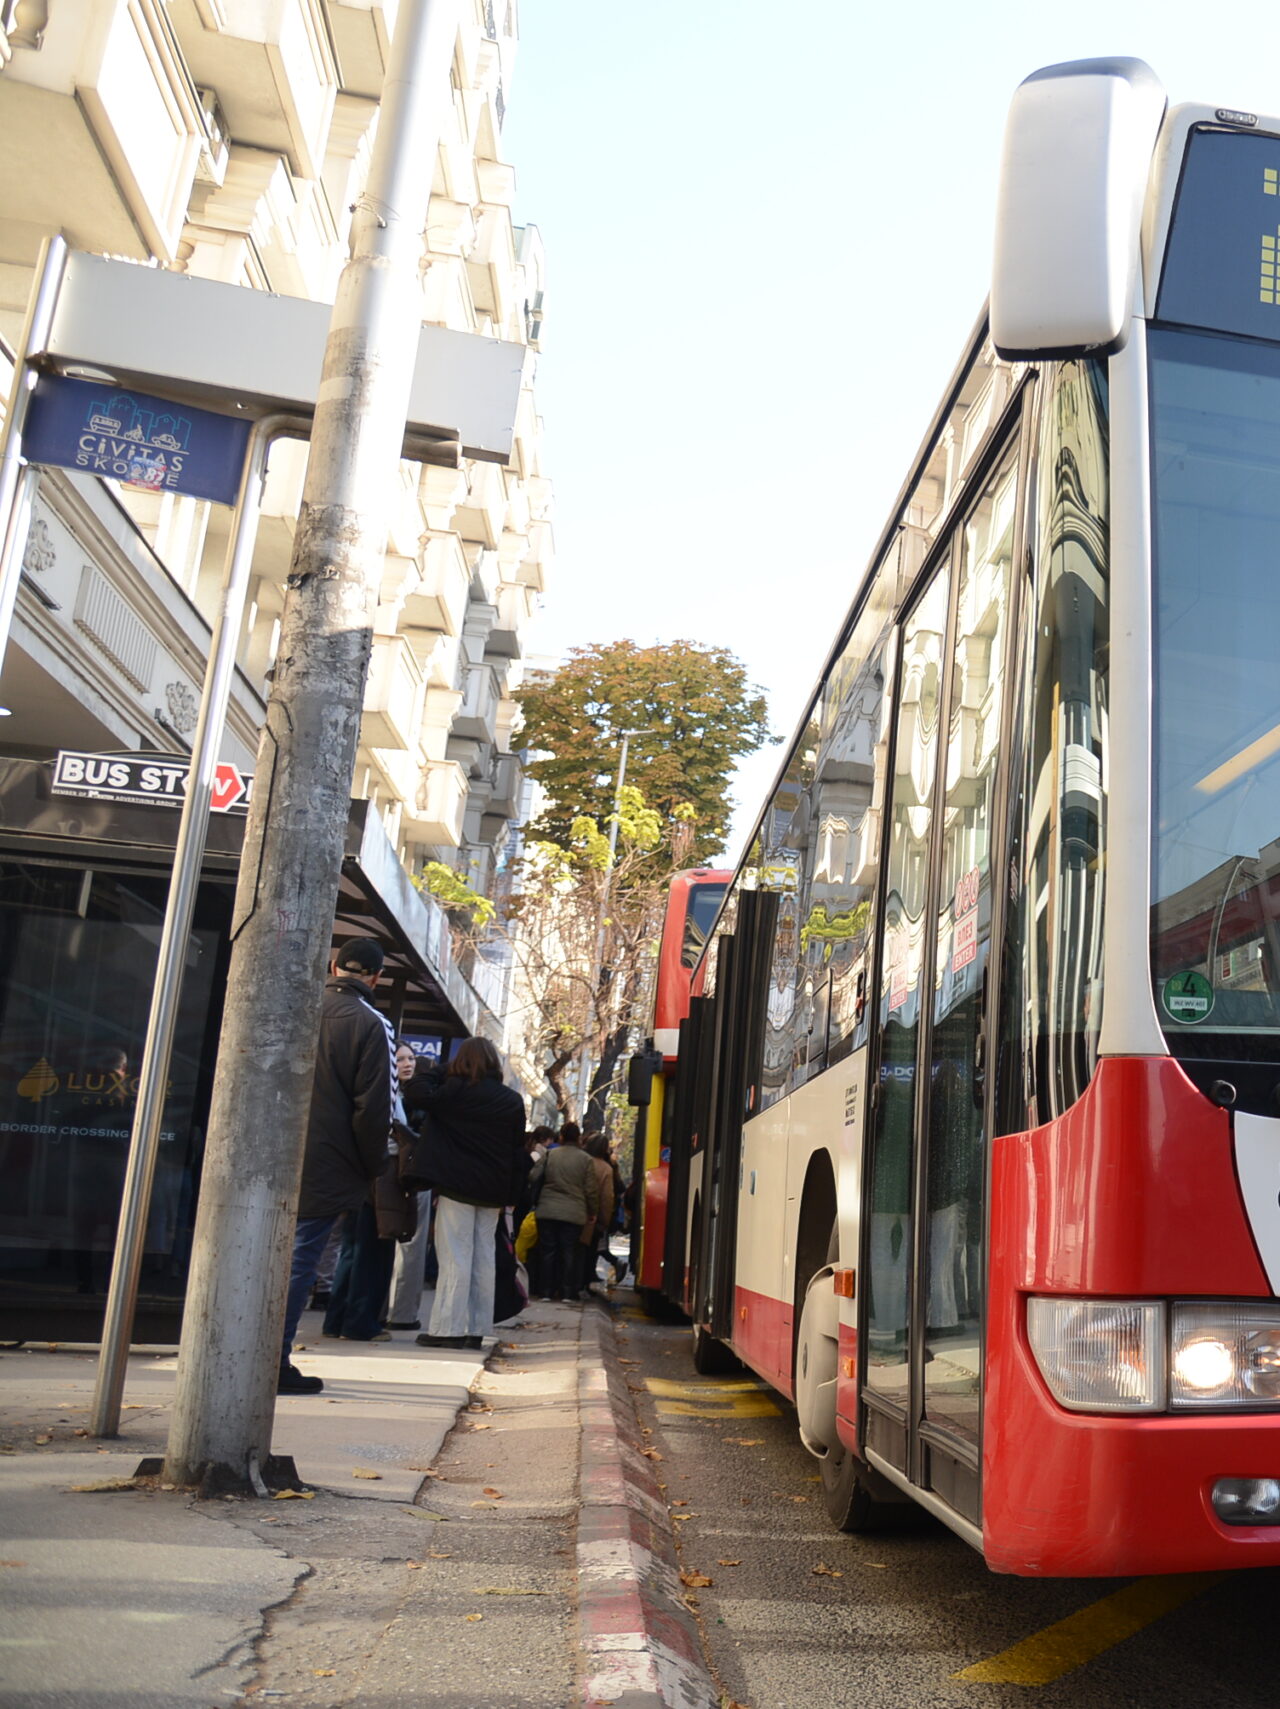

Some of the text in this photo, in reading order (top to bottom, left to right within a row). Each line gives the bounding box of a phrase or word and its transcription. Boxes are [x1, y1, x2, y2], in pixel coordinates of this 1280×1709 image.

[75, 453, 181, 488] SKOE
[61, 757, 130, 788] BUS
[1182, 973, 1197, 996] 4
[0, 1122, 57, 1135] BORDER
[60, 1126, 129, 1139] CROSSING
